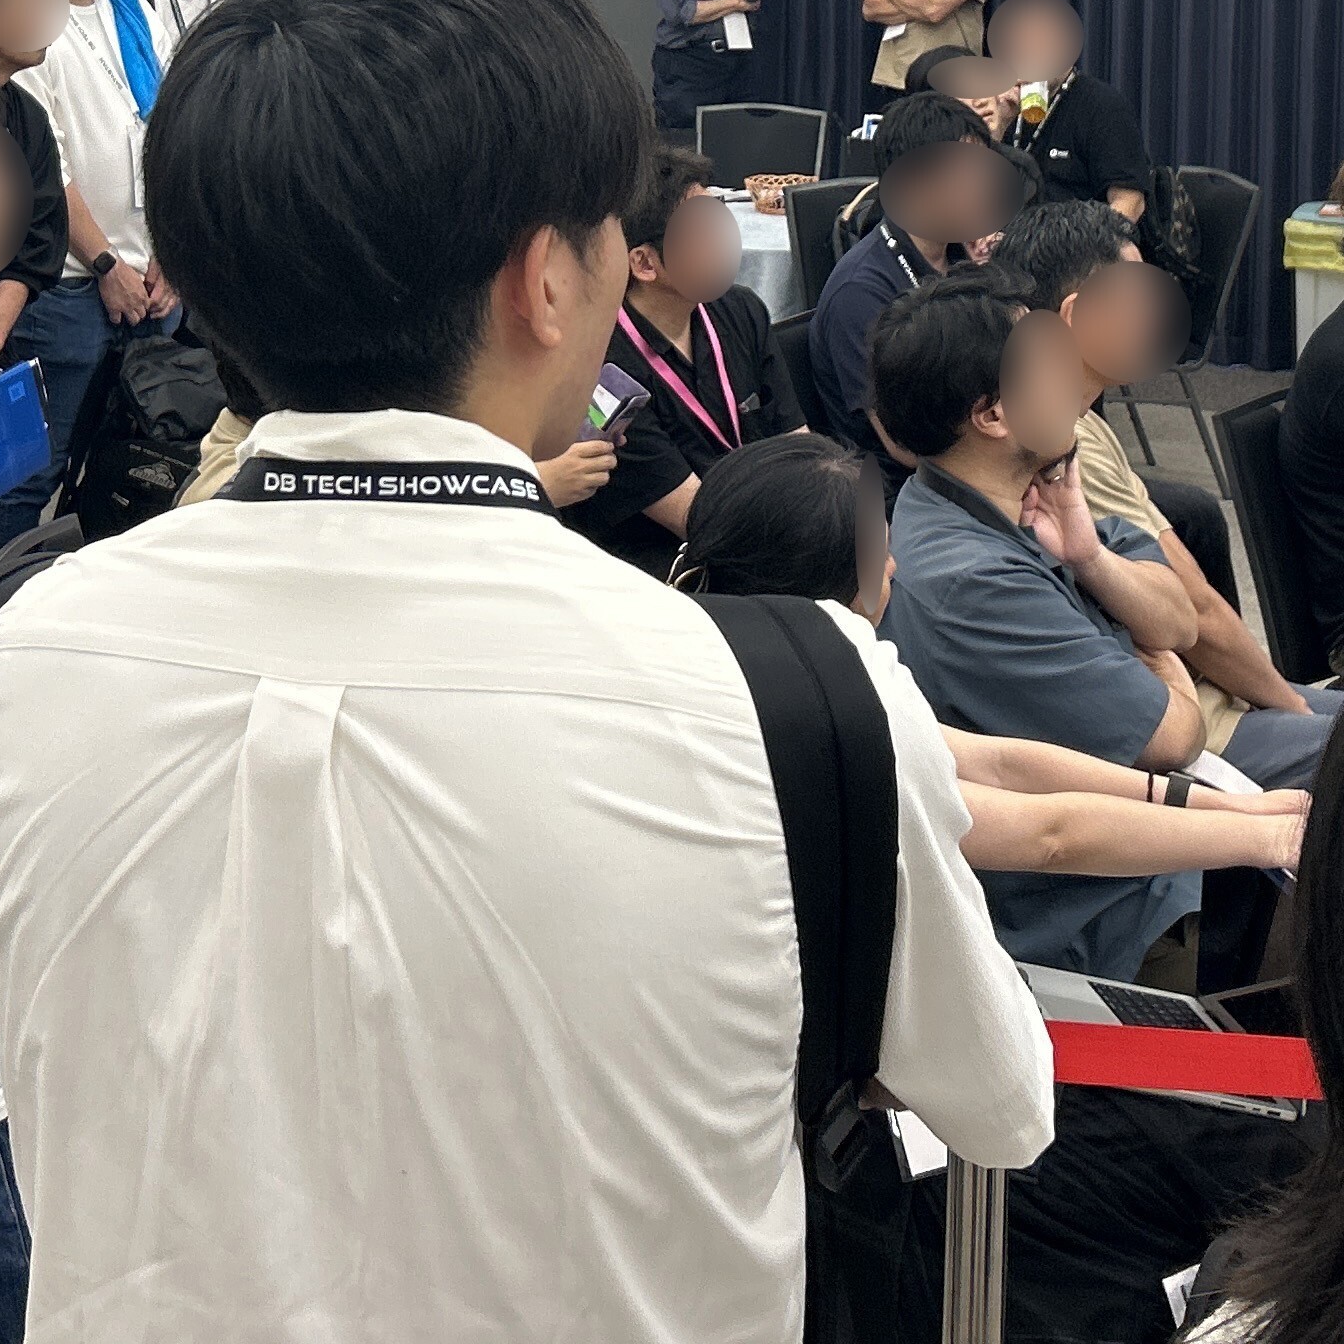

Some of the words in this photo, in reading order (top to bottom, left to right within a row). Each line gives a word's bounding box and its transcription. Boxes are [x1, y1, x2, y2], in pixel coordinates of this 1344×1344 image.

[264, 472, 297, 493] DB
[303, 474, 372, 495] TECH
[378, 474, 540, 500] SHOWCASE
